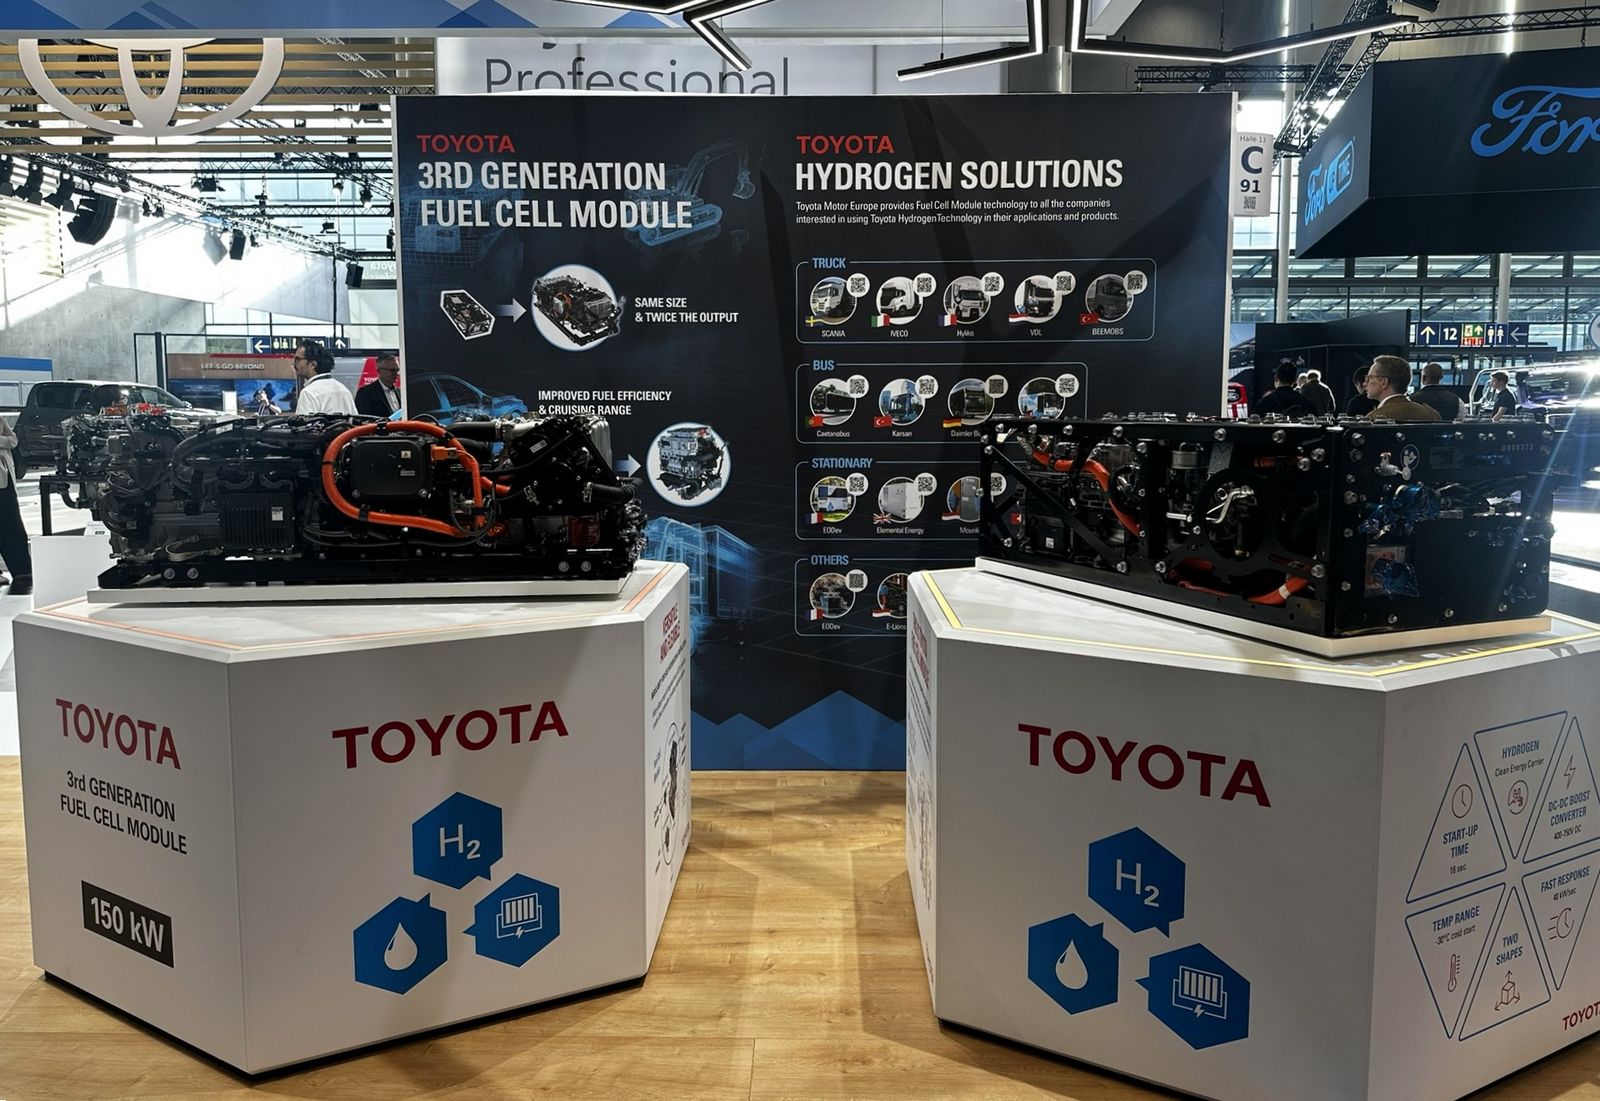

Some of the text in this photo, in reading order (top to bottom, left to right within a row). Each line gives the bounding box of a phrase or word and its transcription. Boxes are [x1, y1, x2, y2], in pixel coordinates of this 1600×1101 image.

[485, 57, 788, 95] Professional
[416, 135, 516, 153] TOYOTA
[796, 135, 895, 154] TOYOTA
[1240, 135, 1257, 143] Halle
[1241, 145, 1264, 174] C
[418, 161, 666, 190] 3RD GENERATION
[795, 159, 1124, 191] HYDROGEN SOLUTIONS
[1240, 179, 1261, 193] 91
[796, 198, 1111, 212] Toyota Motor Europe provides Fuel Cell Module technology to all the companies
[421, 200, 693, 229] FUEL CELL MODULE
[796, 214, 836, 224] interested
[837, 215, 846, 223] in
[847, 214, 869, 225] using
[870, 214, 896, 225] Toyota
[984, 213, 992, 222] in
[993, 212, 1011, 222] their
[1013, 212, 1062, 223] applications
[1064, 212, 1080, 221] and
[1081, 211, 1120, 222] products.
[812, 257, 846, 269] TRUCK
[634, 297, 687, 308] SAME SIZE
[634, 312, 739, 323] & TWICE THE OUTPUT
[821, 329, 846, 338] SCANIA
[890, 329, 909, 338] IVECO
[1030, 328, 1043, 337] VDL
[1092, 327, 1124, 336] BEEMOBS
[1443, 327, 1458, 341] 12
[813, 360, 835, 371] BUS
[538, 390, 672, 401] IMPROVED FUEL EFFICIENCY
[538, 404, 632, 416] & CRUISING RANGE
[892, 429, 912, 438] Karsan
[811, 458, 873, 469] STATIONARY
[876, 526, 925, 535] Elemental Energy
[810, 554, 849, 566] OTHERS
[56, 698, 181, 770] TOYOTA
[332, 701, 569, 769] TOYOTA
[1502, 739, 1540, 759] HYDROGEN
[1018, 723, 1271, 808] TOYOTA
[1495, 757, 1545, 777] Clean Energy Carrier
[66, 770, 176, 822] 3rd GENERATION
[1549, 790, 1591, 812] DC-DC BOOST
[60, 794, 188, 855] FUEL CELL MODULE
[1551, 806, 1587, 826] CONVERTER
[1442, 824, 1478, 844] START-UP
[1451, 842, 1470, 858] TIME
[1541, 866, 1590, 893] FAST RESPONSE
[91, 896, 164, 953] 150 kW
[1432, 905, 1480, 932] TEMP RANGE
[1502, 933, 1518, 948] TWO
[1496, 946, 1523, 966] SHAPES
[1562, 1001, 1600, 1031] TOYOT
